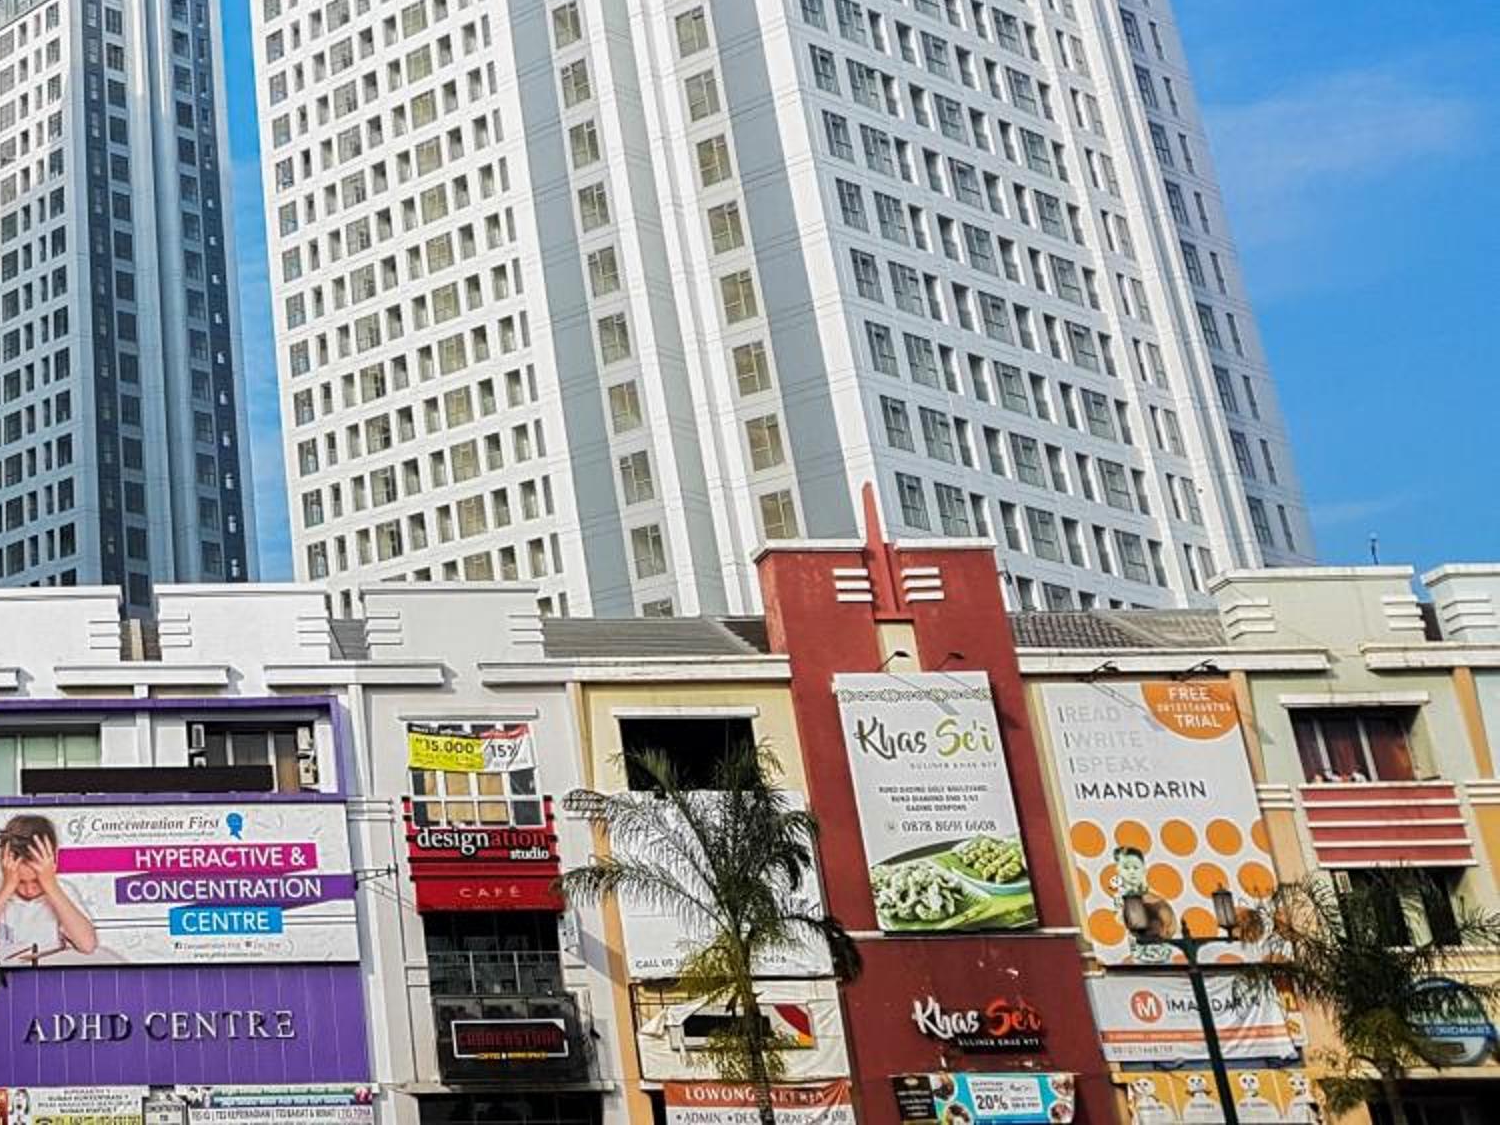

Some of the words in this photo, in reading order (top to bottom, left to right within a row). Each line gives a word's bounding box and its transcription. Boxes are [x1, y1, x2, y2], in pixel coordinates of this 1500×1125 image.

[1168, 686, 1211, 701] FREE
[1173, 714, 1222, 729] TRIAL
[854, 716, 928, 760] Khas
[91, 818, 183, 832] Concentration
[189, 816, 219, 830] First
[134, 848, 284, 868] HYPERACTIVE
[290, 847, 307, 866] &
[509, 846, 549, 860] studio
[126, 878, 322, 901] CONCENTRATION
[181, 911, 271, 932] CENTRE
[23, 1012, 133, 1045] ADHD
[144, 1010, 297, 1043] CENTRE
[912, 995, 980, 1040] Khas
[975, 1094, 1009, 1111] 20%
